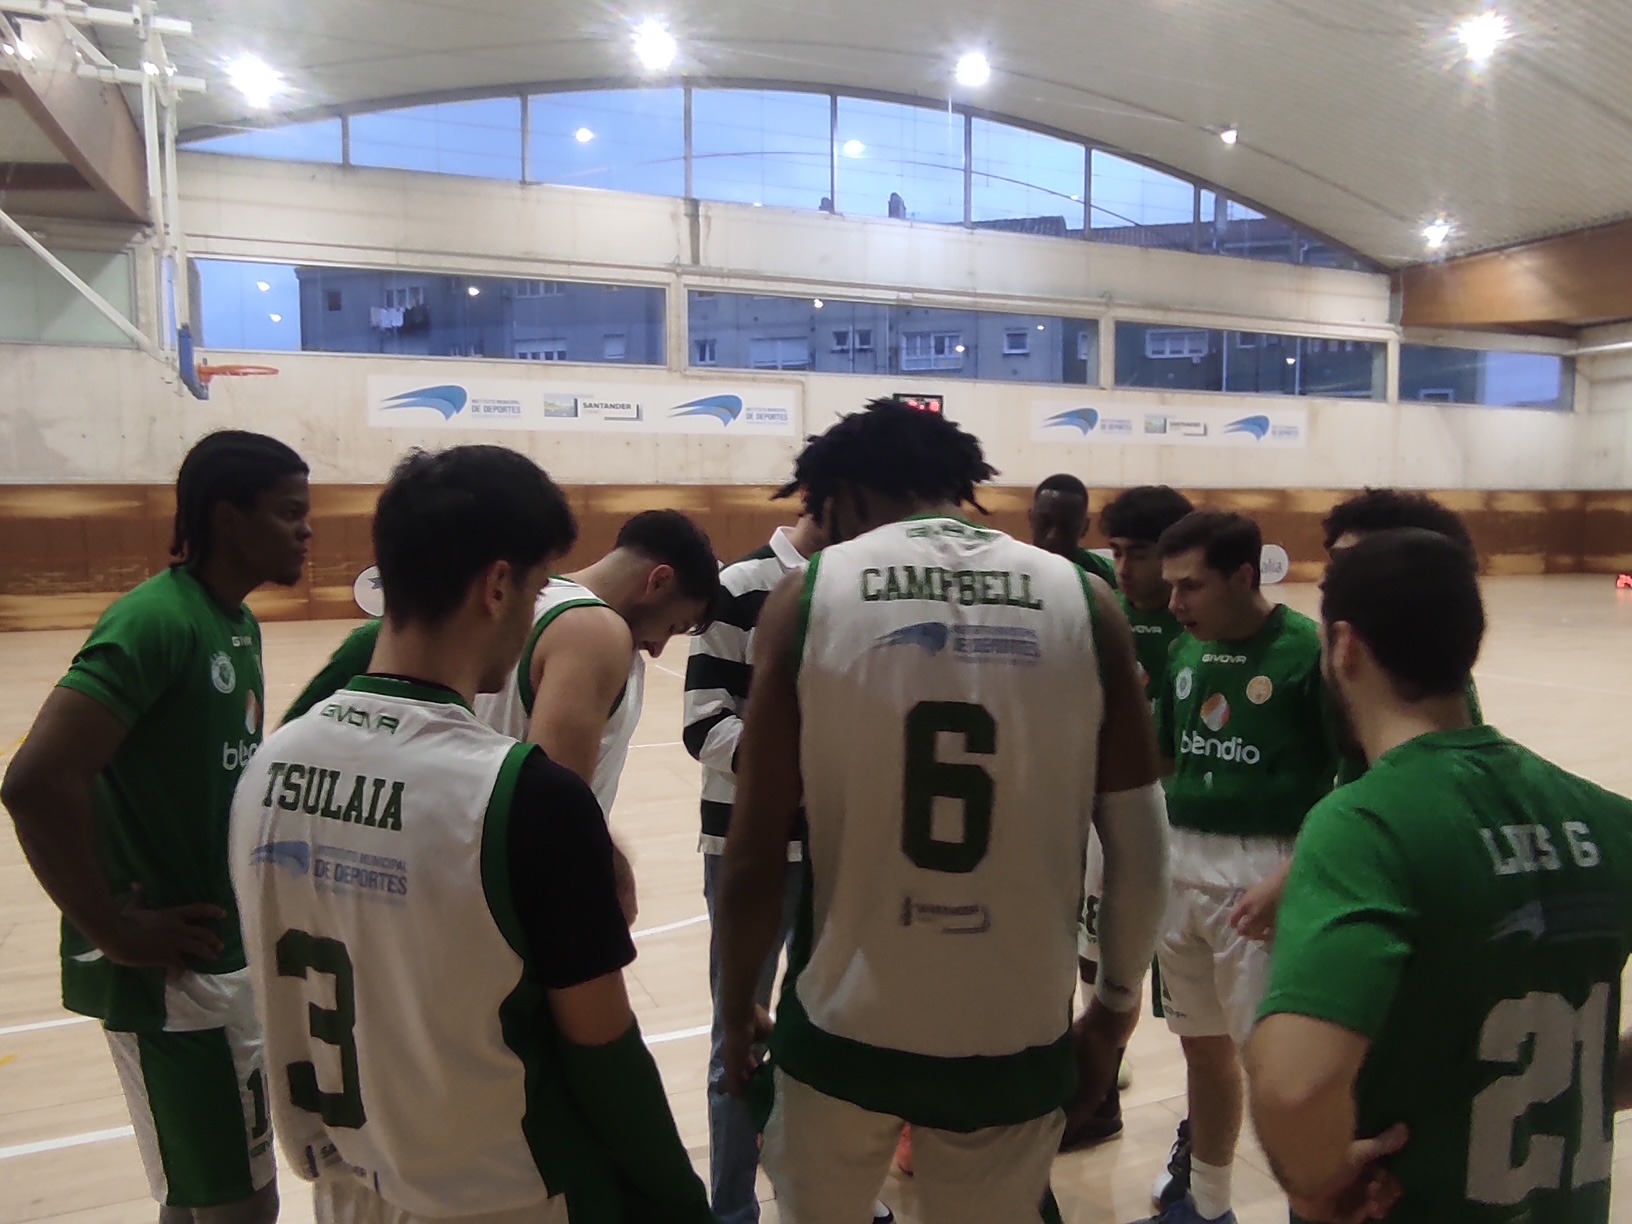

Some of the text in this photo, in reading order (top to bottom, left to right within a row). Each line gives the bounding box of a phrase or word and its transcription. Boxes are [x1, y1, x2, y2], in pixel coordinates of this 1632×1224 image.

[471, 405, 522, 414] DE DEPORTES
[582, 402, 632, 410] SANTANDER
[861, 564, 1044, 611] CAMPBELL
[1131, 624, 1163, 635] VOVA
[1202, 653, 1248, 665] GIVOVA
[262, 761, 406, 832] TSULAIA
[902, 700, 997, 874] 6
[313, 858, 331, 879] DE
[333, 863, 408, 896] DEPORTES
[275, 927, 368, 1130] 3
[1465, 981, 1613, 1206] 21
